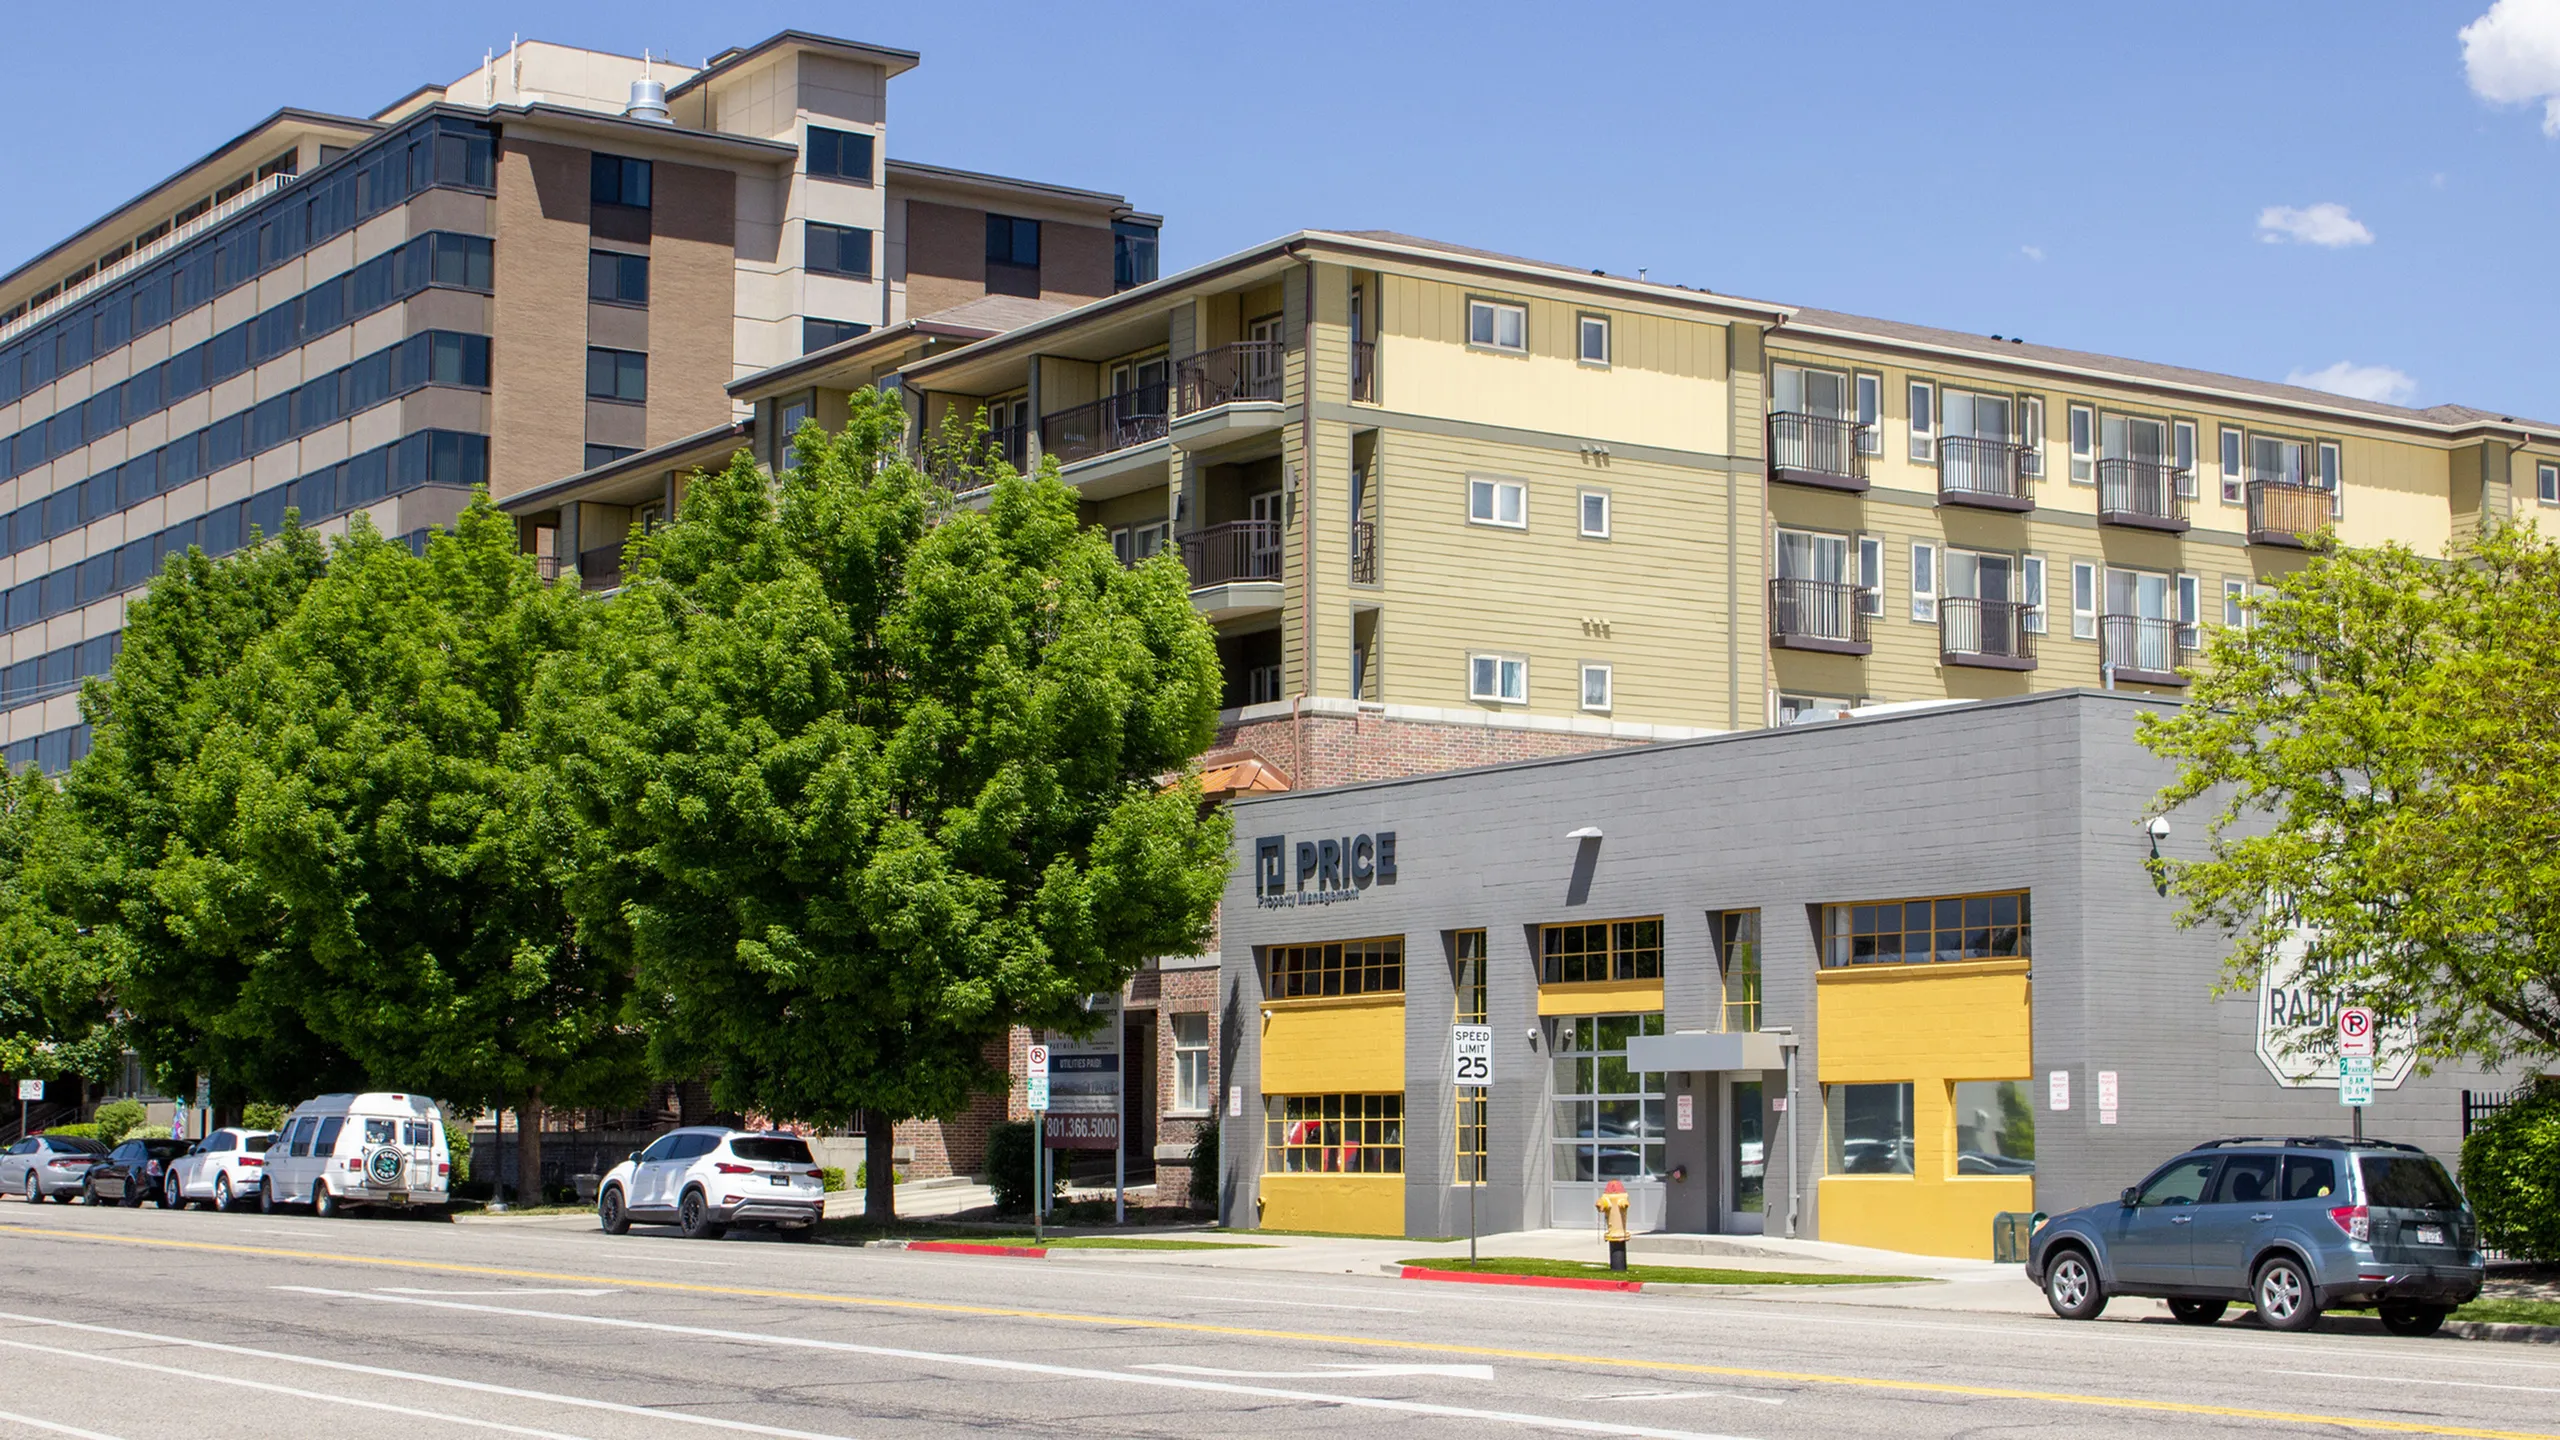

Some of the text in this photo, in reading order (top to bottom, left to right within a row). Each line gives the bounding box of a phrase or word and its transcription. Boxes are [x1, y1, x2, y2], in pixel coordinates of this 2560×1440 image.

[1296, 832, 1397, 883] PRICE
[1257, 888, 1359, 911] Property Management
[1456, 1031, 1489, 1041] SPEED
[1459, 1044, 1485, 1053] LIMIT
[1060, 1058, 1085, 1068] UTILITIES
[1458, 1056, 1488, 1078] 25
[1047, 1118, 1116, 1137] 801.366.5000
